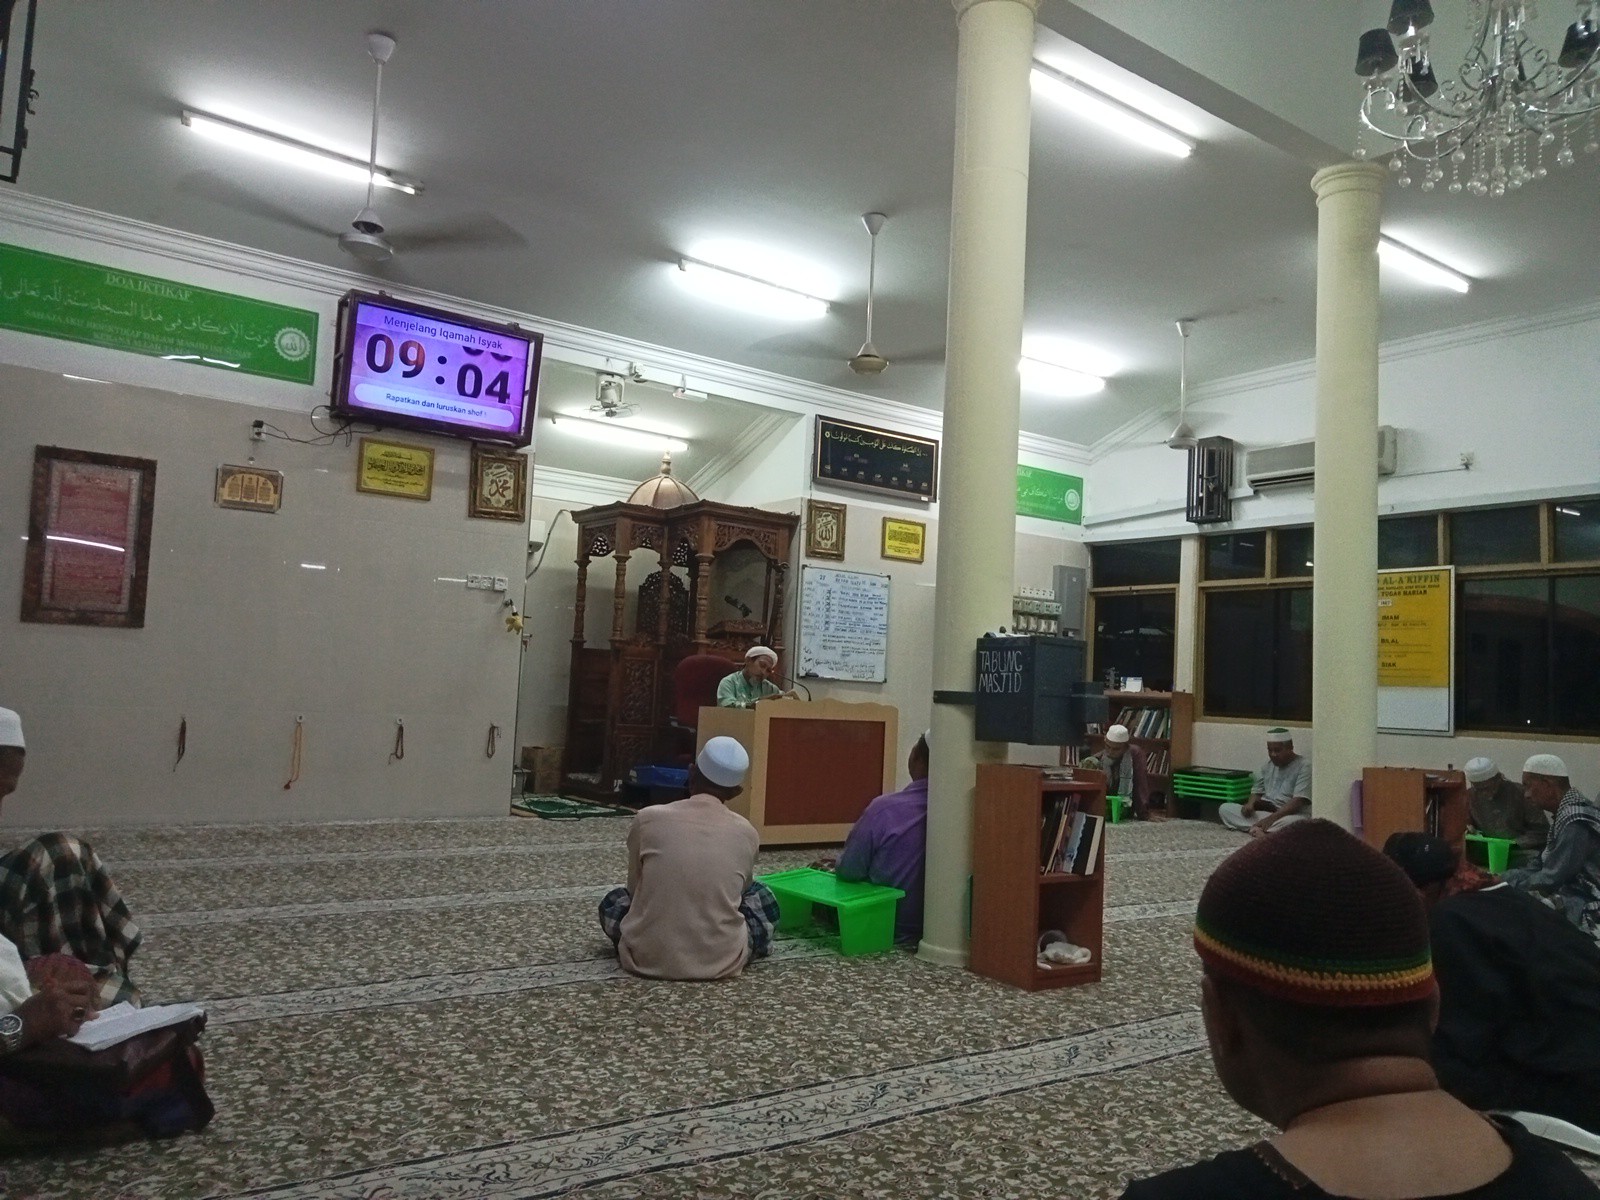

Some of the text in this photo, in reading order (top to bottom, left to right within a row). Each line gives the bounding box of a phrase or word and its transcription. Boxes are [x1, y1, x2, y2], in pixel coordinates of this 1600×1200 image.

[106, 273, 192, 300] DOA IKTIKAF
[384, 315, 503, 350] Menjelang Iqamah Isyak
[386, 393, 420, 407] Rapatkan
[421, 399, 435, 409] dan
[436, 402, 466, 415] luruskan
[978, 672, 1022, 693] MASJID
